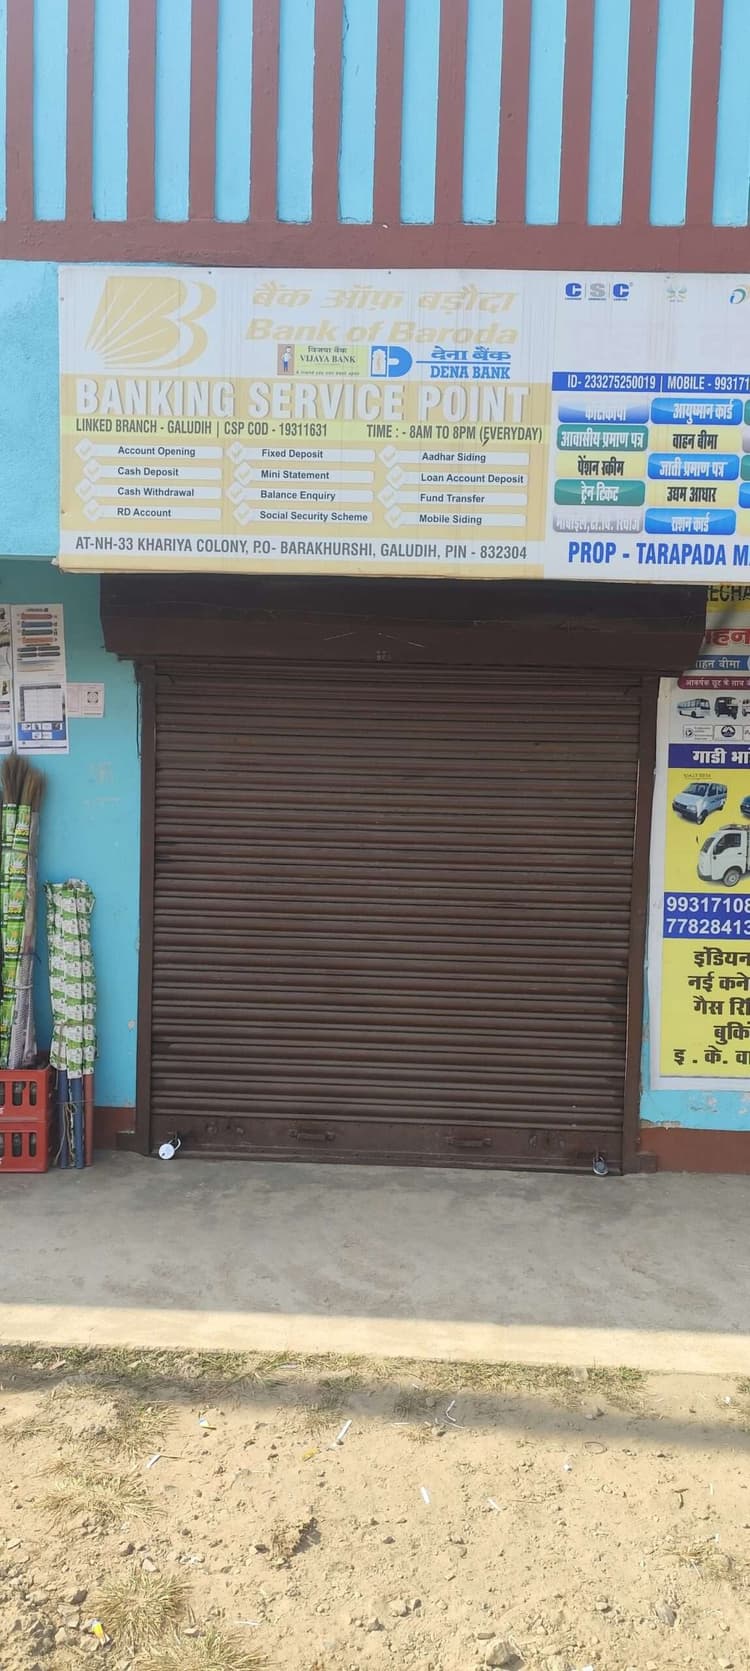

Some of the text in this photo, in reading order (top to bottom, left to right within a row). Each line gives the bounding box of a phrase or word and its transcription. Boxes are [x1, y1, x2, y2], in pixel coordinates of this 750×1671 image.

[252, 281, 312, 307] बैंक
[246, 319, 519, 344] Bank of Baroda
[300, 355, 356, 363] VIJAYA BANK
[431, 345, 511, 361] देना बैंक
[430, 366, 511, 379] DENA BANK
[567, 374, 582, 387] ID-
[584, 375, 656, 389] 233275250019
[667, 376, 705, 389] MOBILE
[76, 378, 530, 424] BANKING SERVICE POINT
[715, 398, 734, 419] कार्ड
[76, 419, 112, 432] LINKED
[116, 420, 157, 433] BRANCH
[167, 420, 212, 434] GALUDIH
[224, 421, 244, 435] CSP
[247, 422, 268, 436] COD
[279, 423, 327, 437] 19311631
[366, 424, 392, 438] TIME
[409, 425, 433, 439] 8AM
[436, 426, 449, 439] TO
[452, 426, 476, 440] 8PM
[479, 426, 543, 443] (EVERYDAY)
[561, 427, 645, 449] आवासीय प्रमाण पत्र
[672, 429, 718, 449] वाहन बीमा
[118, 446, 196, 457] Account Opening
[262, 449, 324, 459] Fixed Deposit
[422, 452, 486, 463] Aadhar Siding
[117, 467, 179, 478] Cash Deposit
[577, 455, 624, 476] पेंशन स्कीम
[660, 456, 728, 477] जाती प्रमाण पत्र
[260, 470, 330, 479] Mini Statement
[421, 474, 524, 485] Loan Account Deposit
[117, 487, 194, 497] Cash Withdrawal
[260, 490, 336, 501] Balance Enquiry
[420, 494, 485, 503] Fund Transfer
[580, 481, 619, 504] ट्रेन टिकट
[117, 508, 172, 517] RD Account
[260, 511, 368, 522] Social Security Scheme
[419, 514, 482, 525] Mobile Siding
[75, 536, 133, 550] AT-NH-33
[137, 537, 192, 551] KHARIYA
[196, 539, 249, 555] COLONY,
[280, 541, 376, 558] BARAKHURSHI,
[380, 544, 440, 559] GALUDIH,
[445, 545, 467, 559] PIN
[480, 545, 527, 559] 832304
[568, 541, 616, 563] PROP
[636, 543, 726, 566] TARAPADA
[733, 544, 750, 566] M
[705, 585, 750, 602] ECHA
[731, 748, 750, 764] भा
[667, 896, 750, 913] 99317108
[666, 918, 750, 935] 77828413
[688, 971, 750, 992] नई कने
[693, 995, 750, 1016] गैस रि
[673, 1049, 686, 1066] इ
